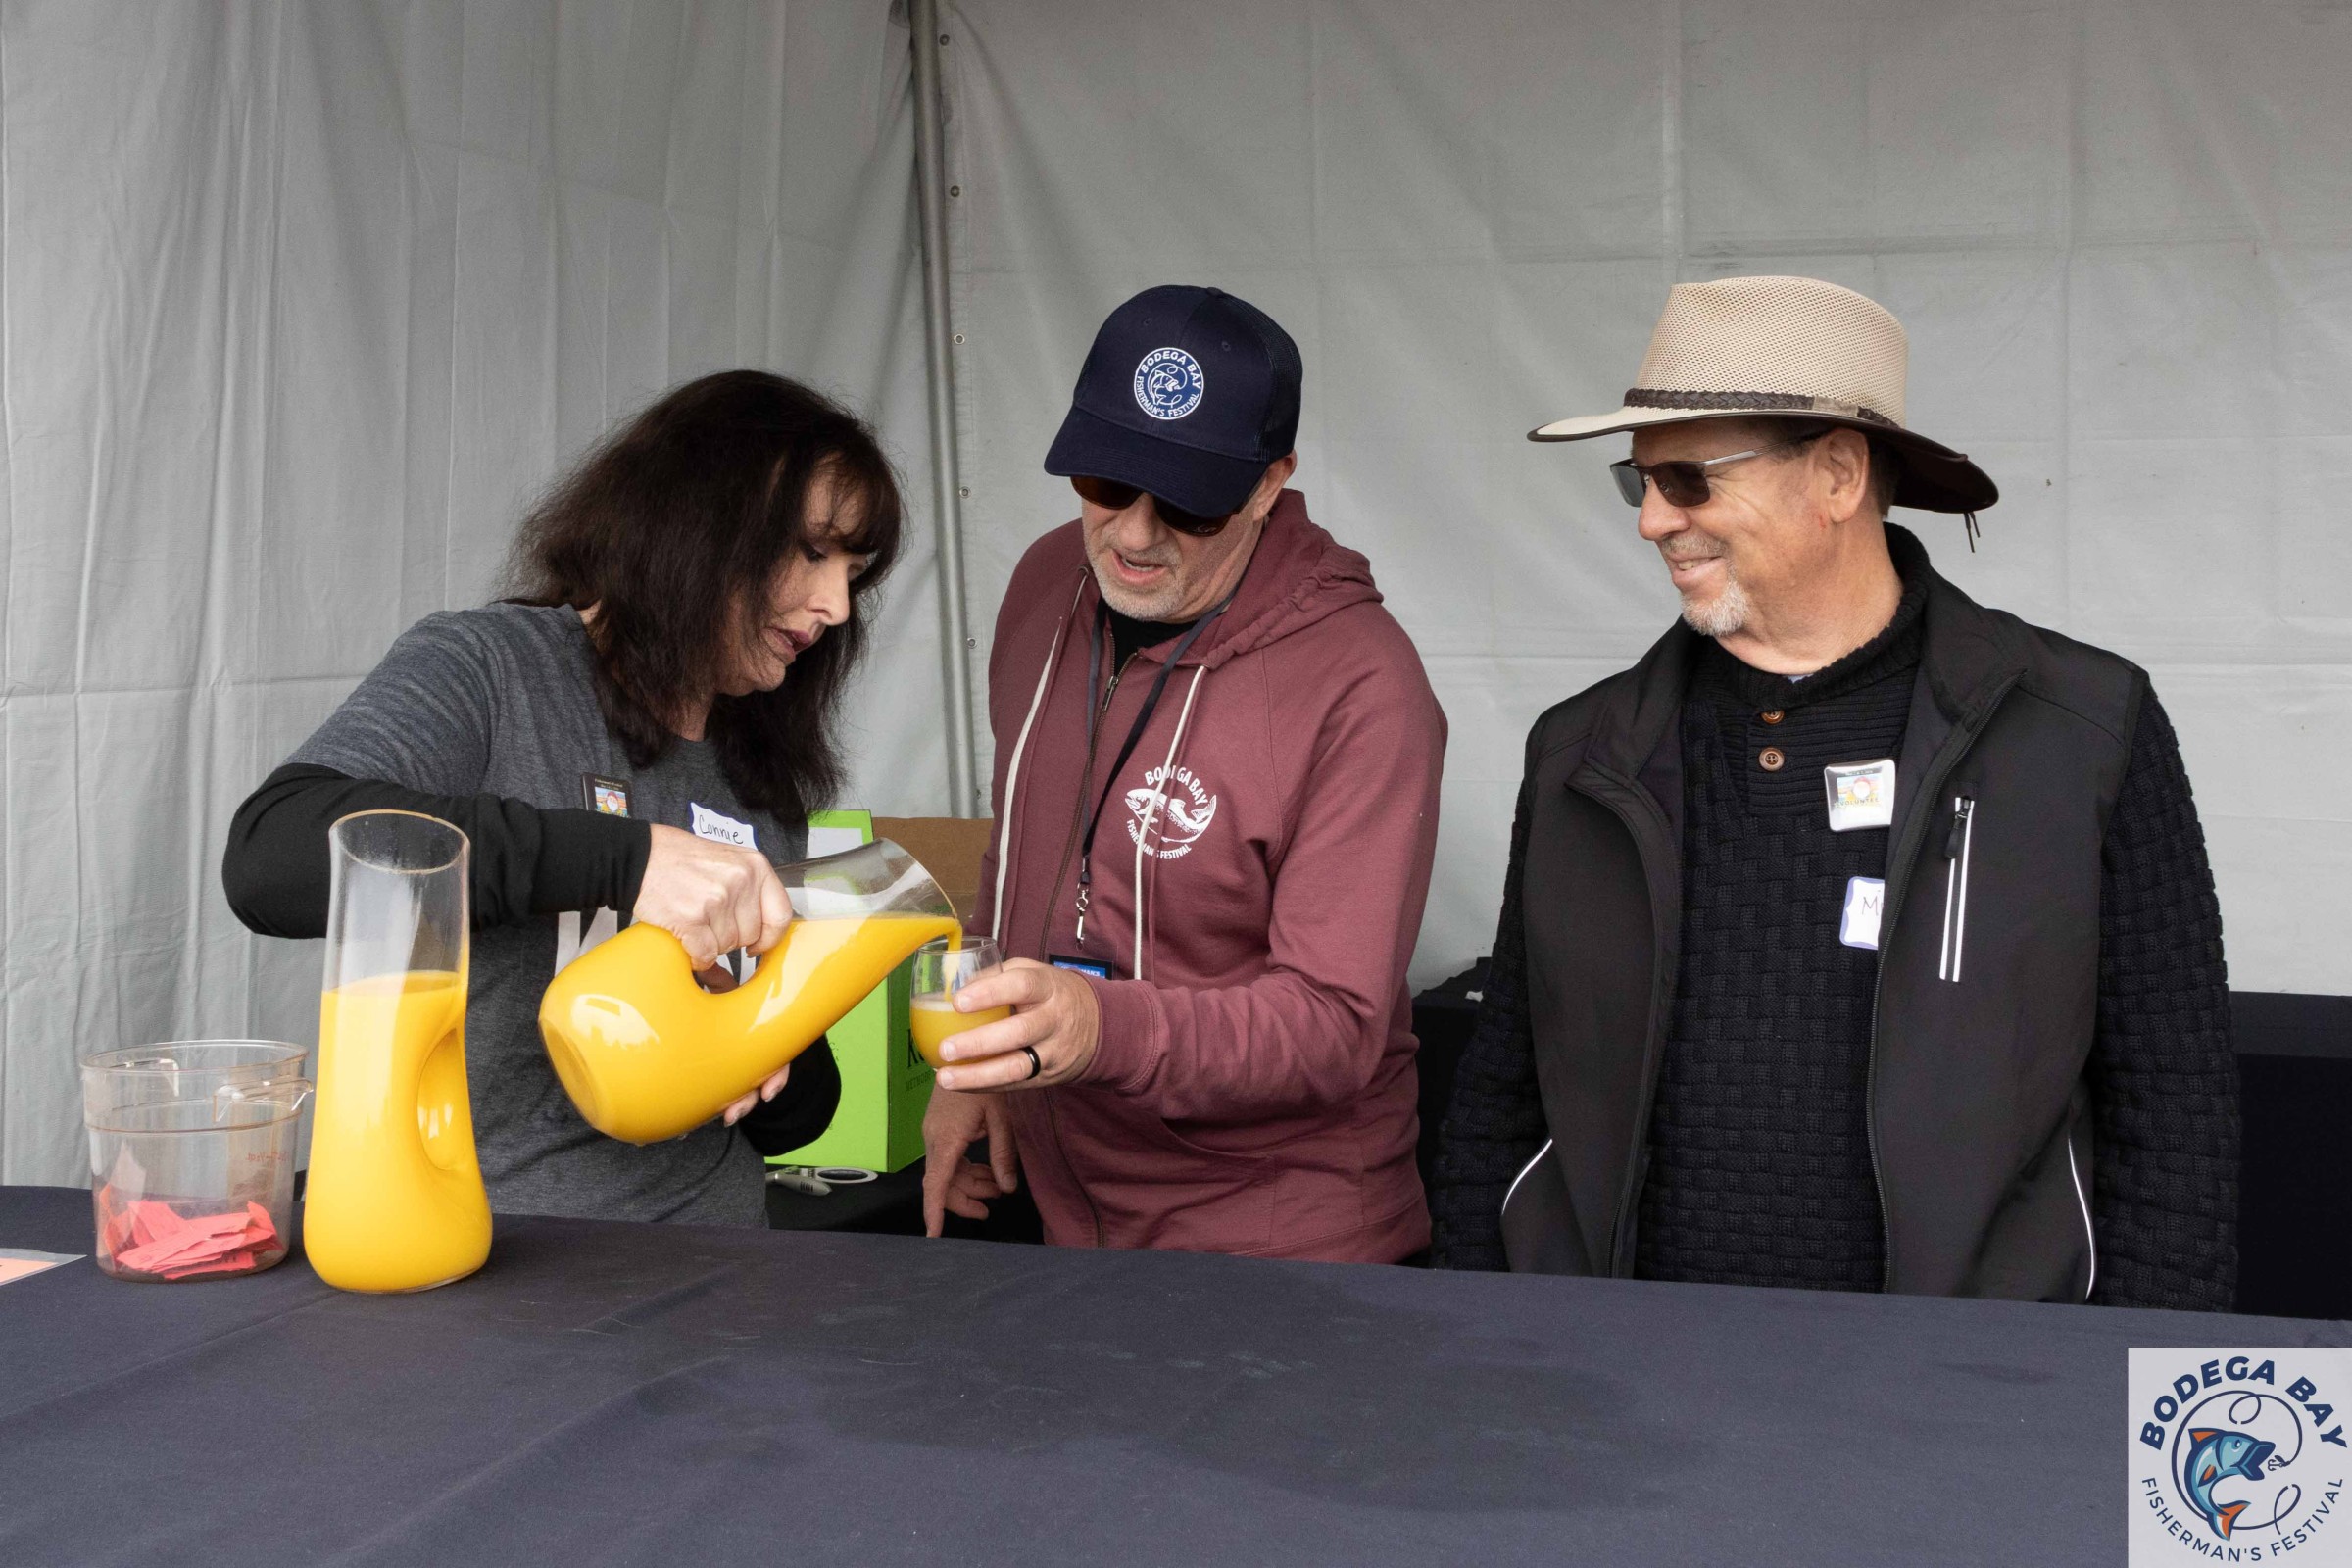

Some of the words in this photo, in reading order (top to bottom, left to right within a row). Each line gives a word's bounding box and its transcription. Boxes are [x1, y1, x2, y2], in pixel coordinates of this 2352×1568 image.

[1141, 351, 1187, 373] BODEGA
[1187, 364, 1201, 390] BAY
[1137, 376, 1164, 416] FISHERMAN'S
[1168, 393, 1199, 416] FESTIVAL
[1189, 778, 1208, 805] BAY
[699, 814, 744, 845] Connie
[1159, 844, 1192, 859] FESTIVAL
